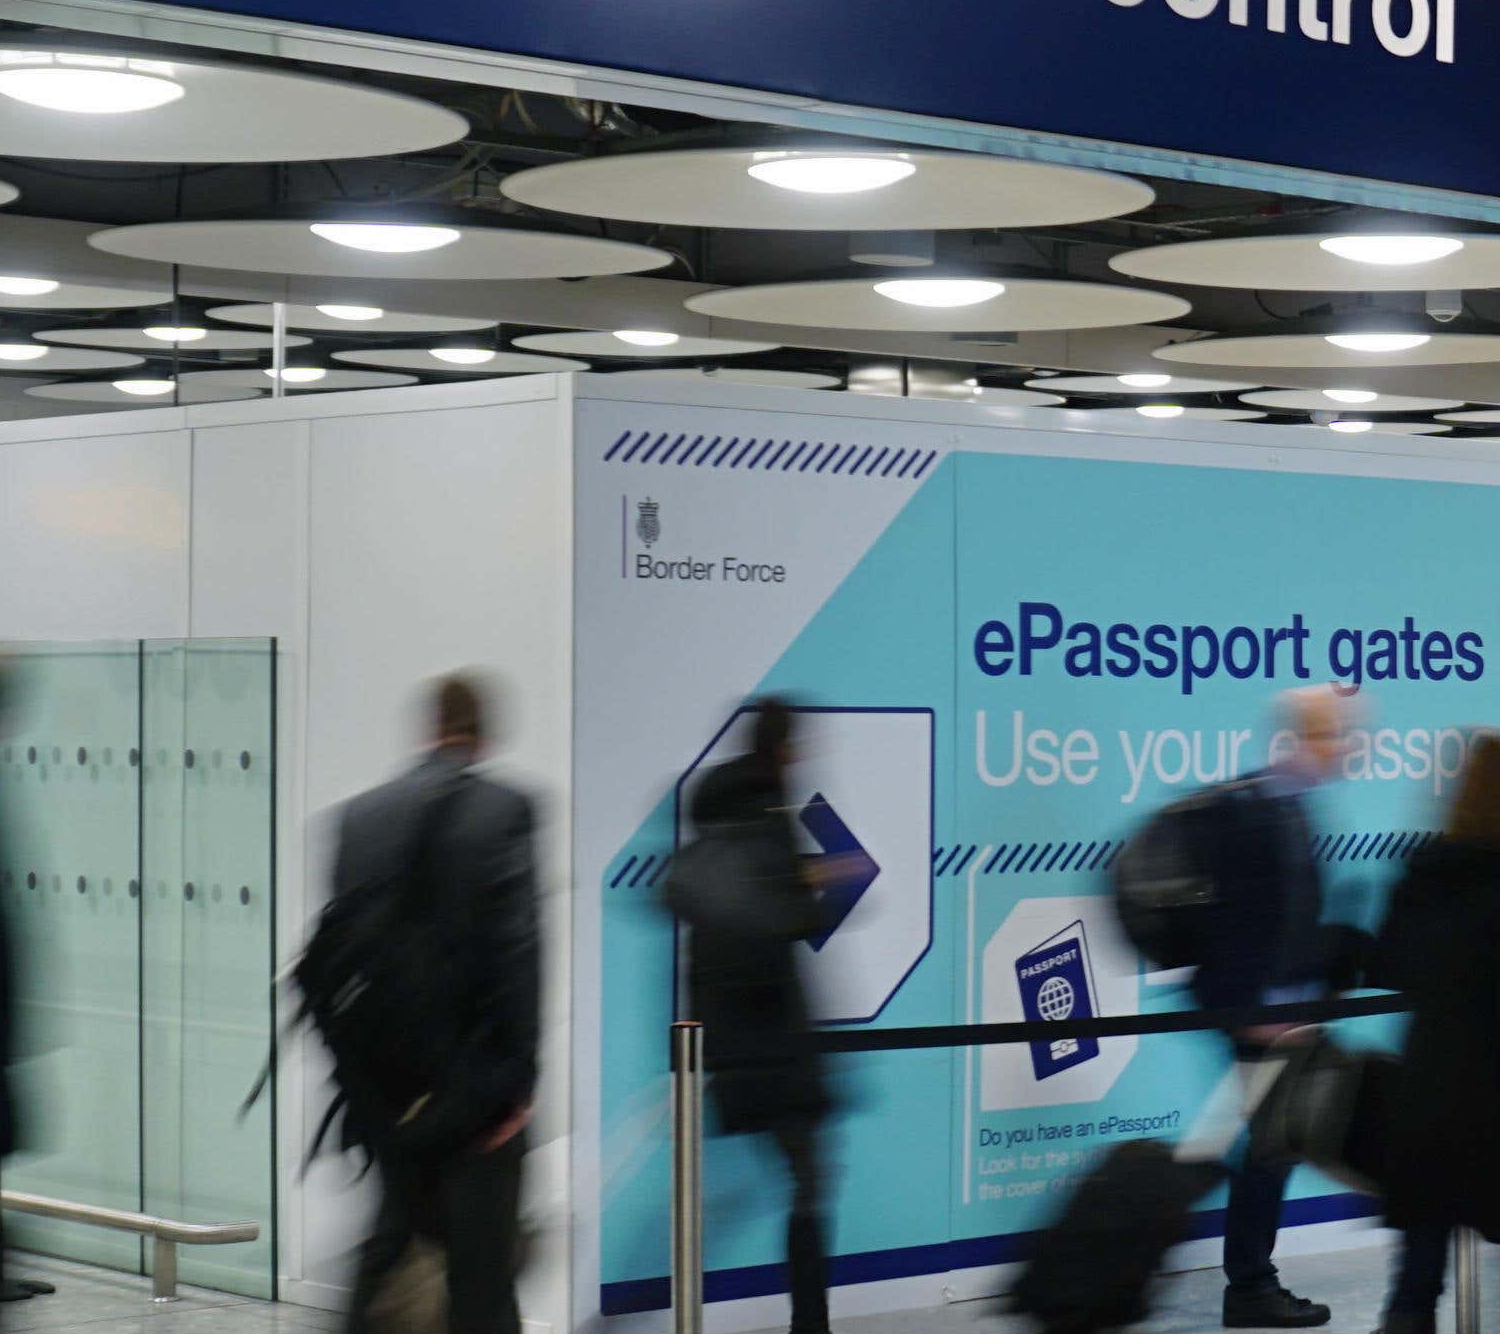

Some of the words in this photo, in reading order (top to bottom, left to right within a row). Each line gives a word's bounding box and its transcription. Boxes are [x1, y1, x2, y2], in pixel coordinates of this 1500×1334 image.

[635, 553, 716, 581] Border
[722, 556, 786, 583] Force
[973, 601, 1311, 696] ePassport
[1327, 616, 1485, 698] gates
[974, 710, 1098, 787] Use
[1118, 727, 1252, 803] your
[1019, 948, 1077, 979] PASSPORT
[979, 1128, 1001, 1147] Do
[1005, 1126, 1033, 1149] you
[1037, 1123, 1073, 1142] have
[1075, 1121, 1096, 1138] an
[1098, 1110, 1181, 1136] ePassport?
